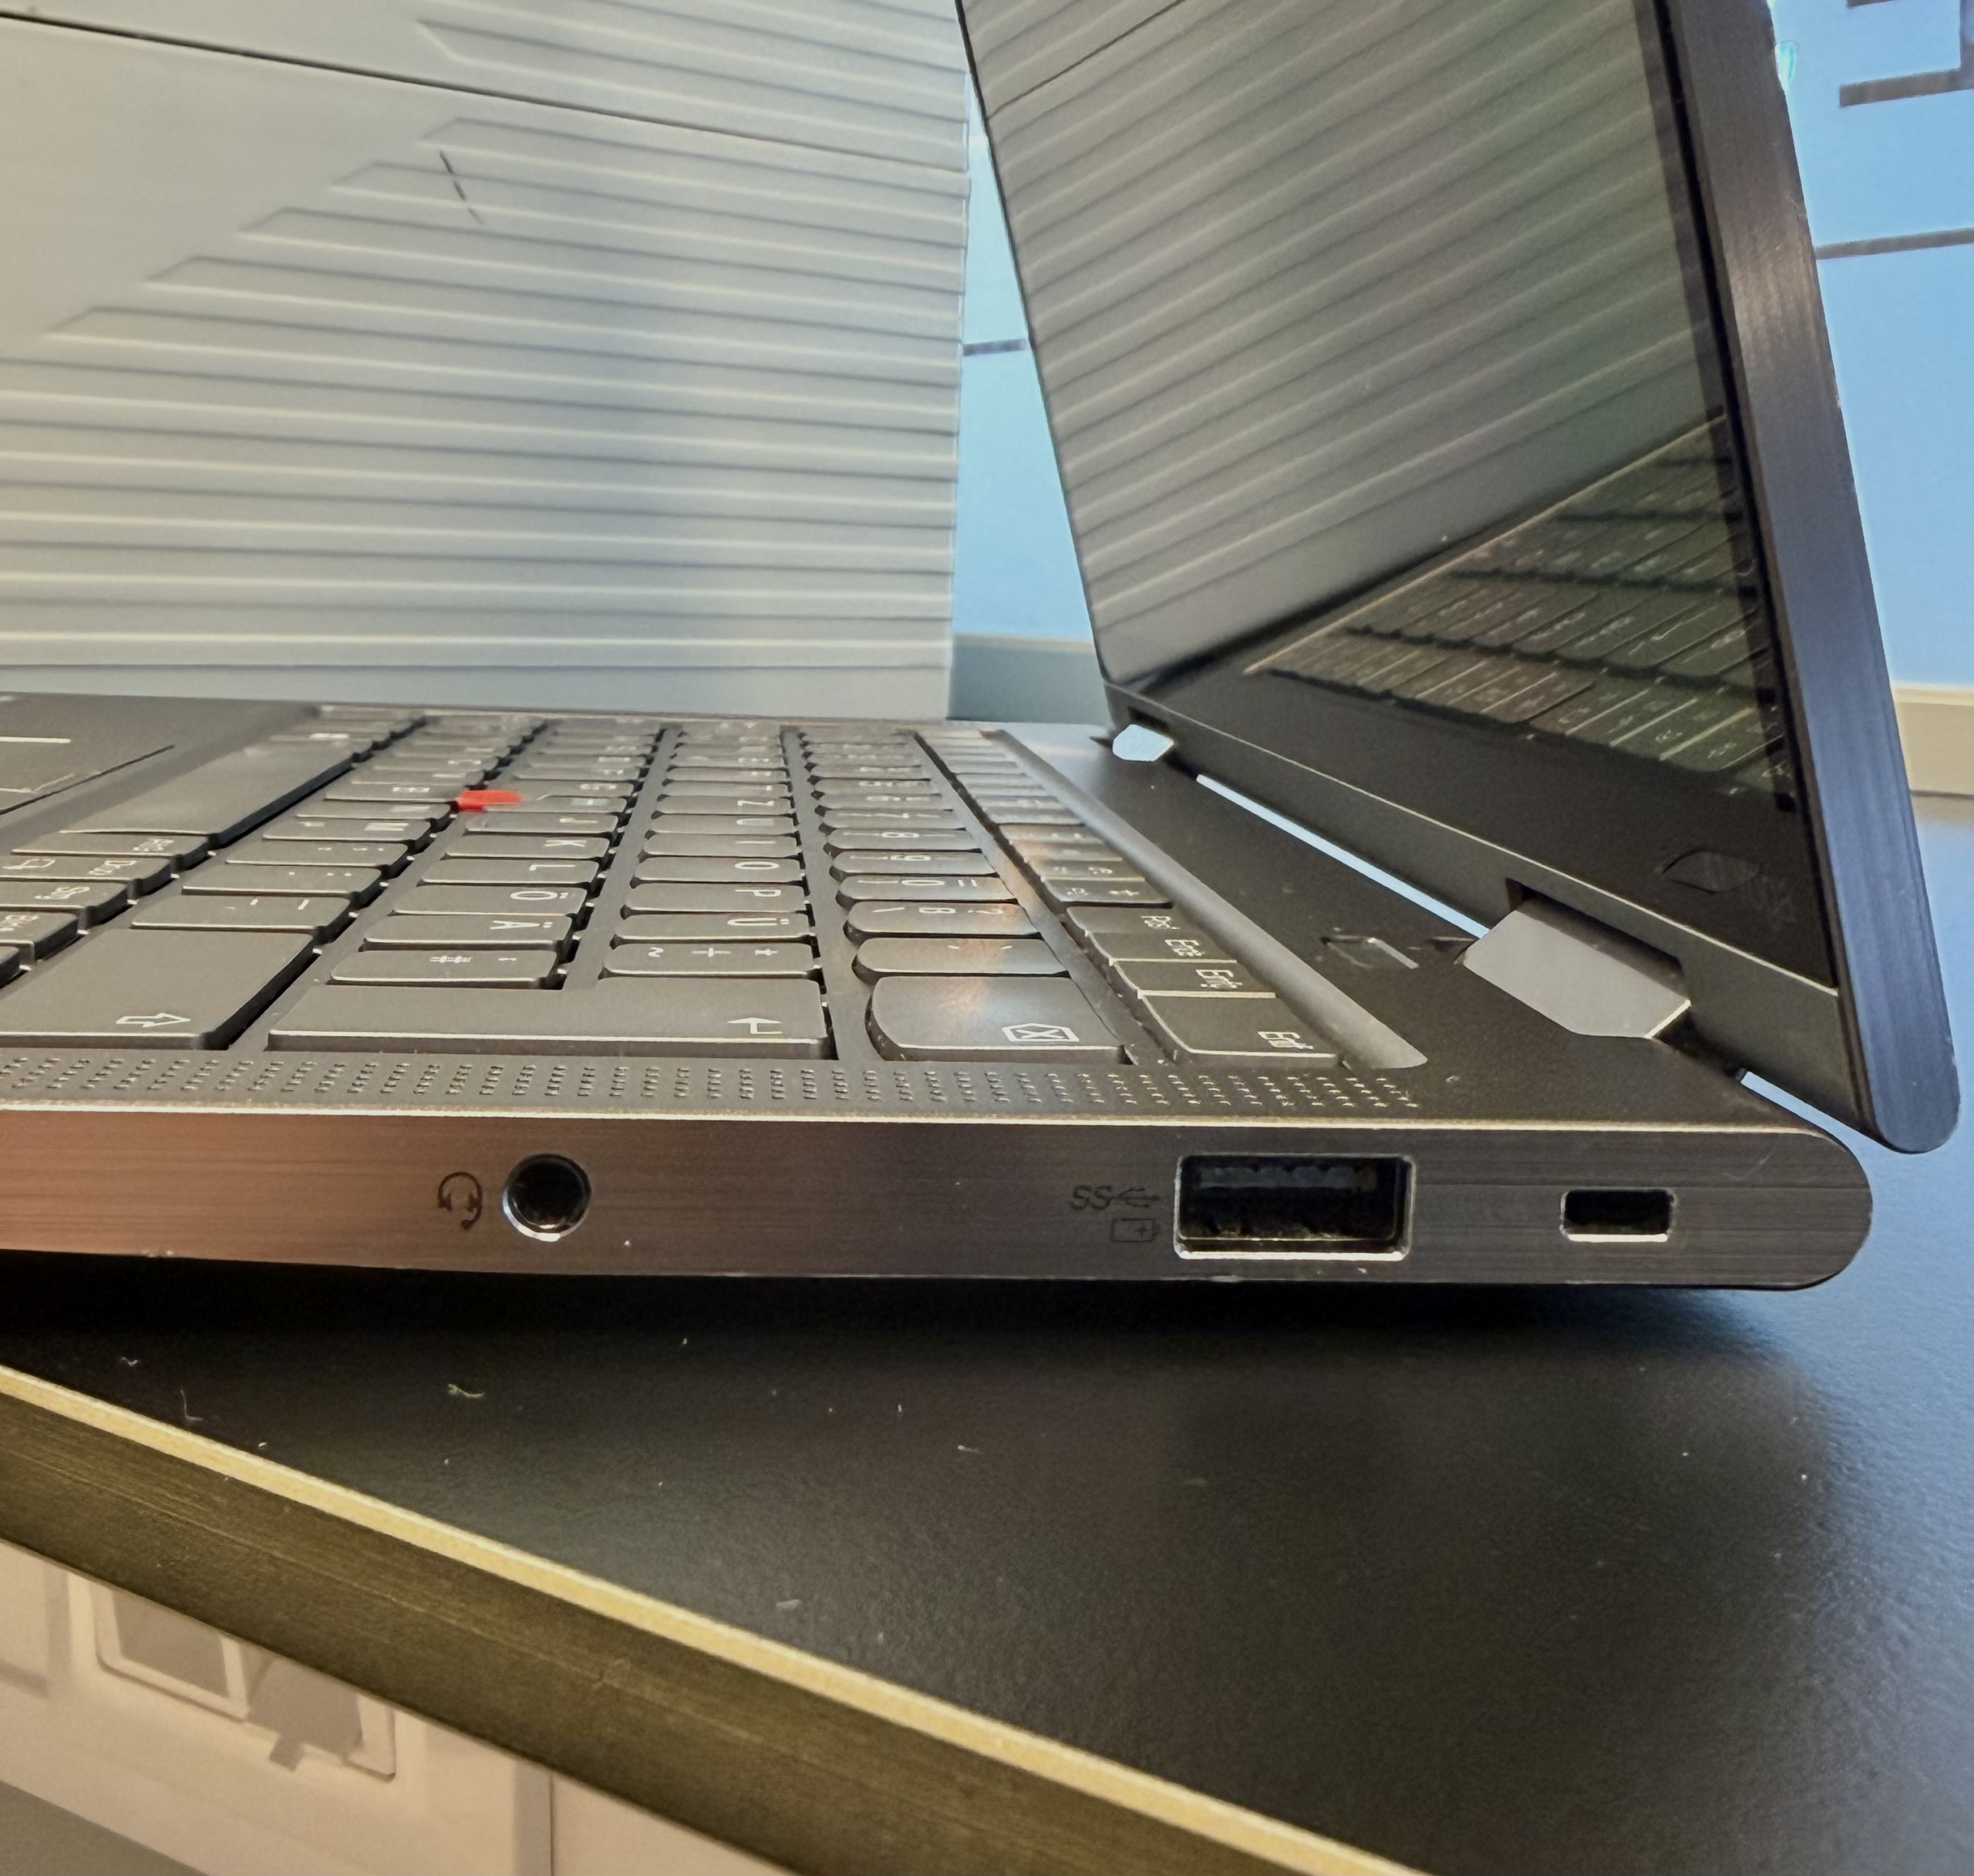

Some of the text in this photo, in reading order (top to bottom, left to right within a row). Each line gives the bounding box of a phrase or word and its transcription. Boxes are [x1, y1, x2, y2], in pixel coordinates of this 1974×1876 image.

[734, 861, 780, 871] O
[735, 888, 781, 898] P
[489, 920, 554, 931] Ä
[727, 917, 790, 928] Ü
